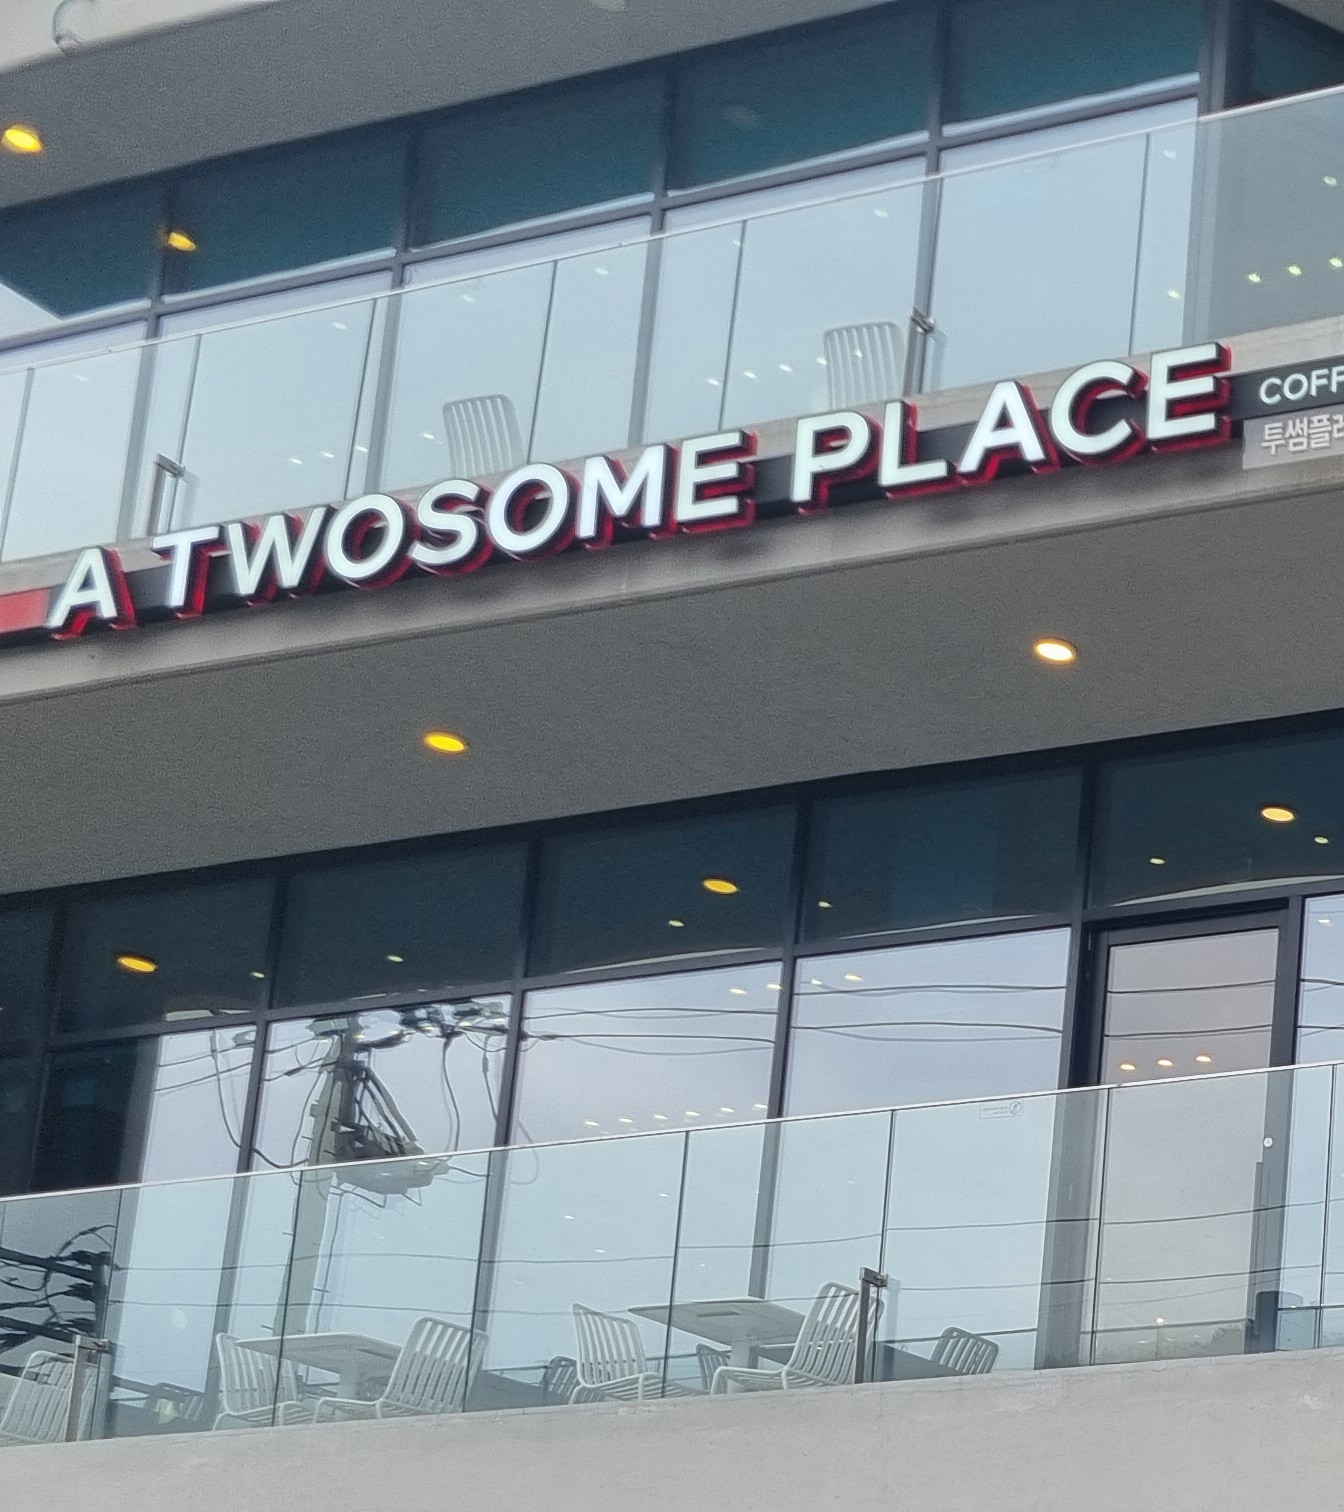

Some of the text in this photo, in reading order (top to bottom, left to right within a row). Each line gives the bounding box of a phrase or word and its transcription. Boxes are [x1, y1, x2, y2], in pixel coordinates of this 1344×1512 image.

[45, 342, 1226, 632] A TWOSOME PLACE
